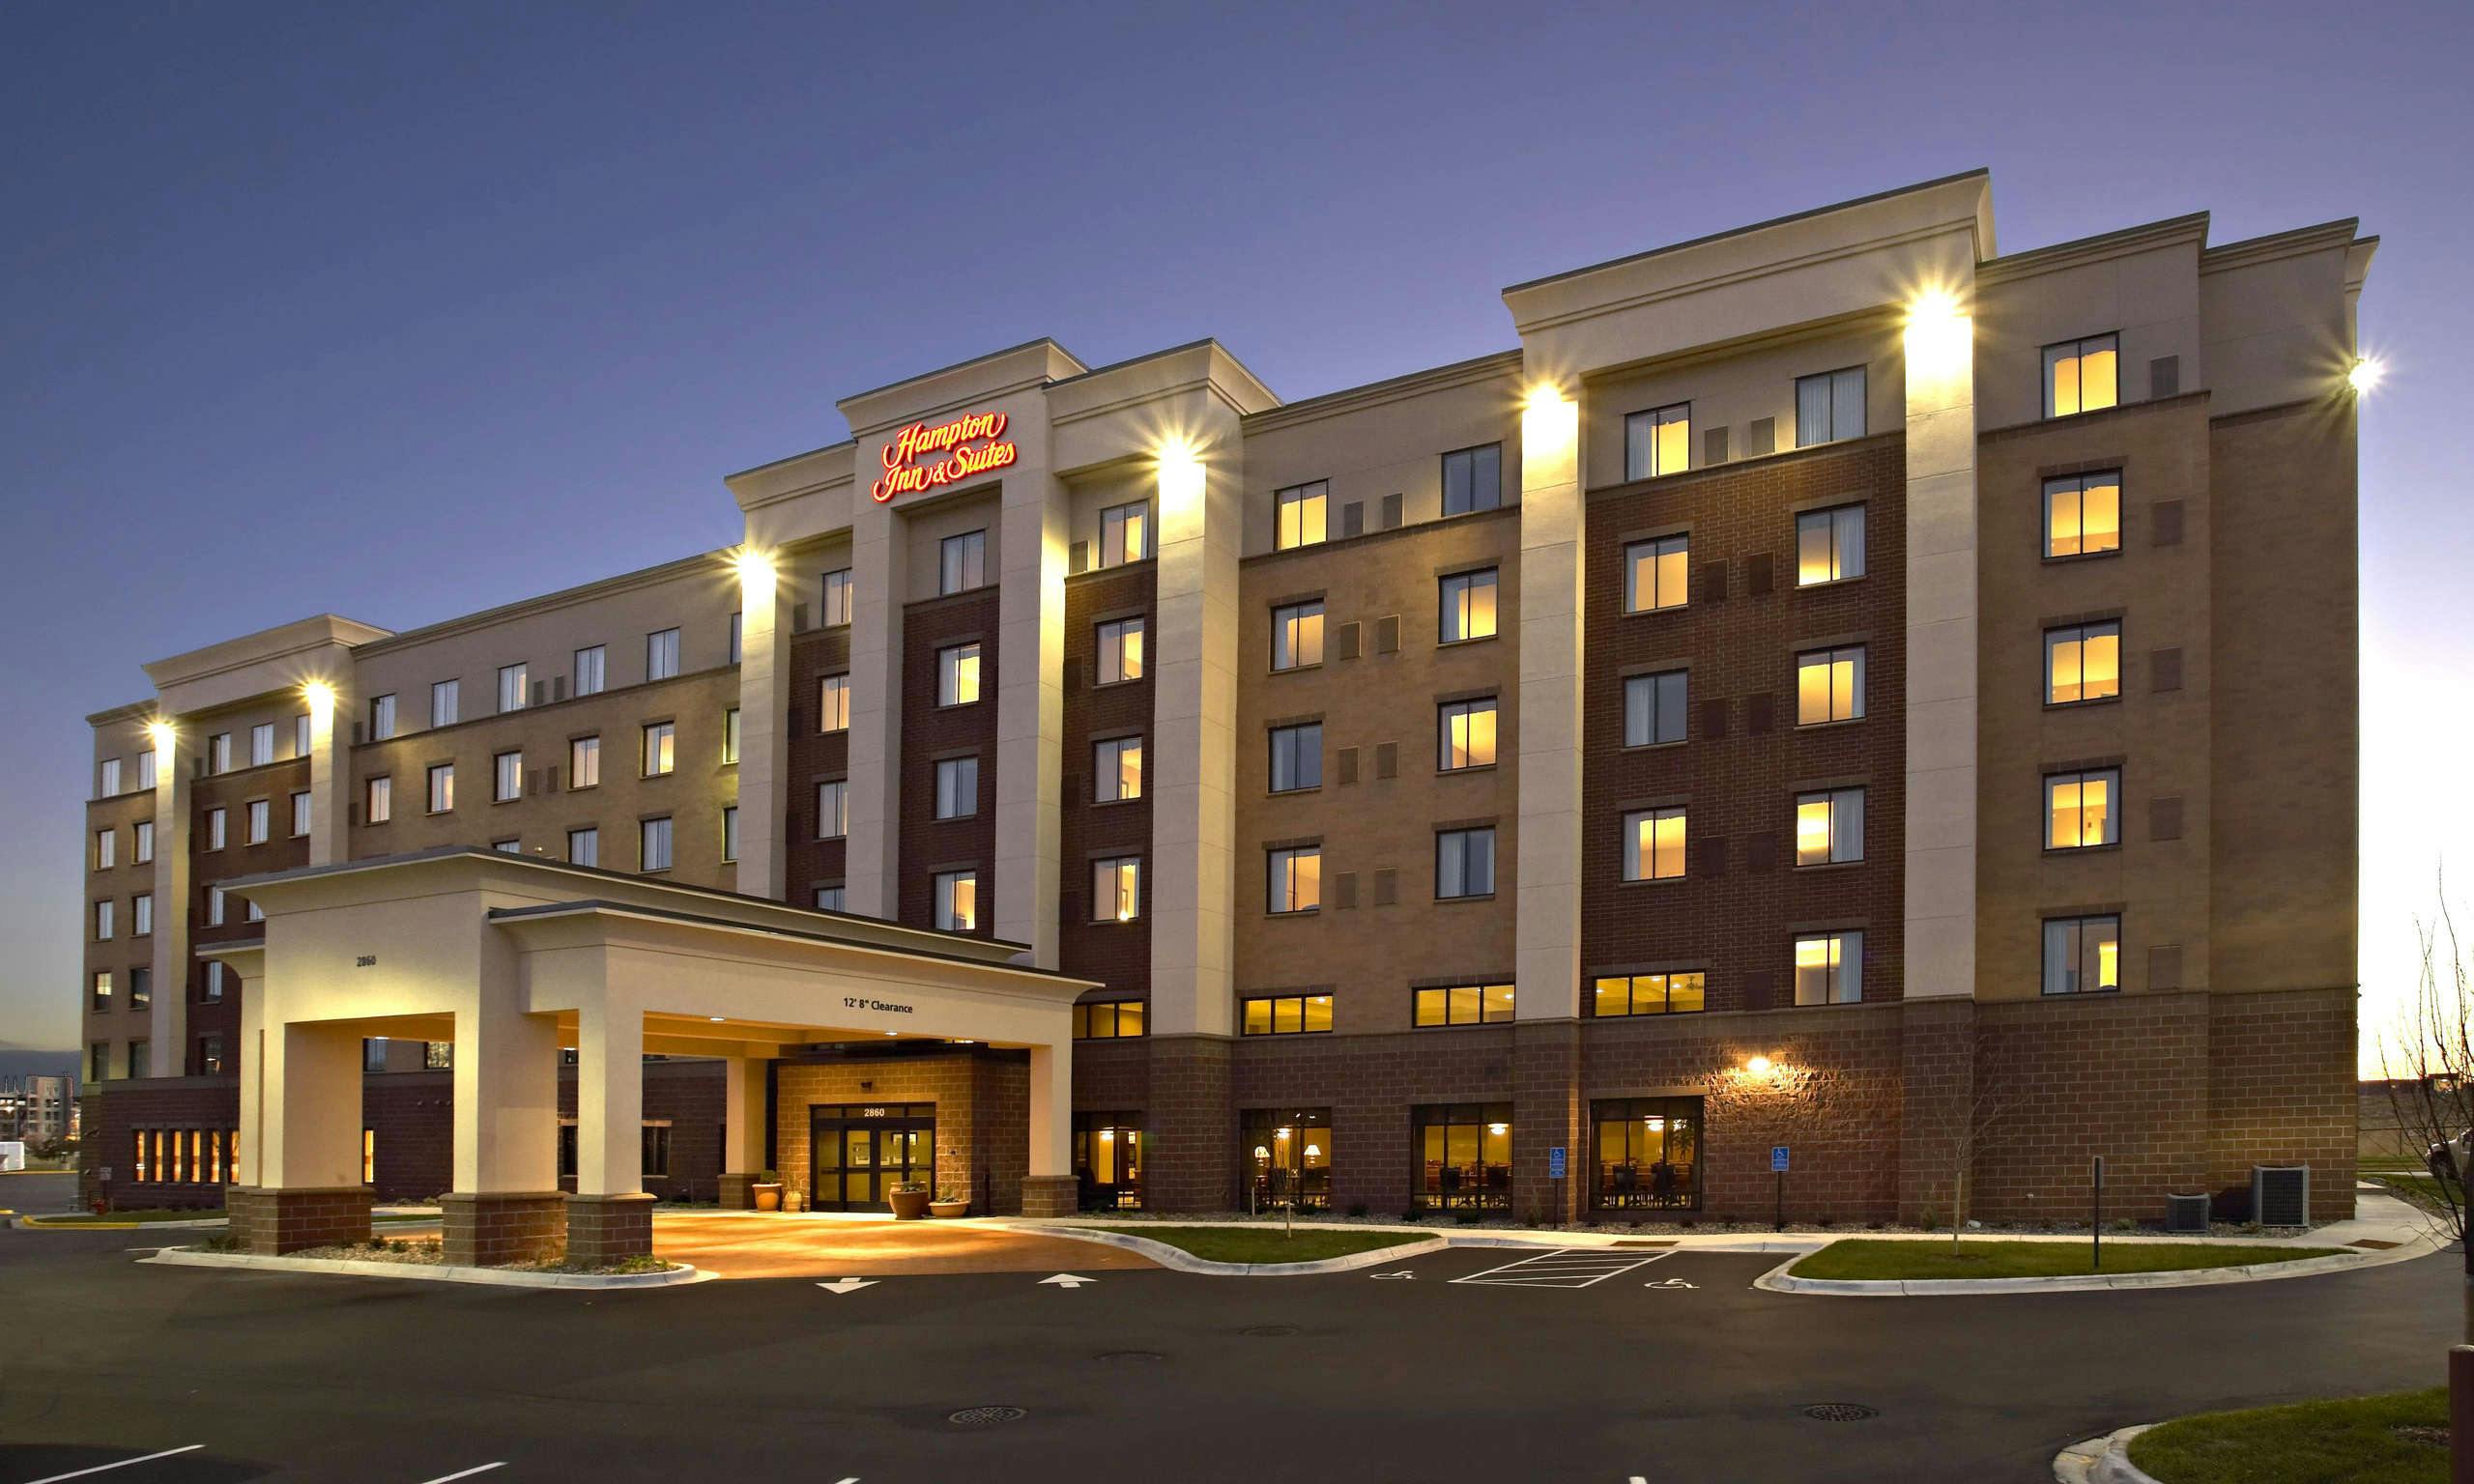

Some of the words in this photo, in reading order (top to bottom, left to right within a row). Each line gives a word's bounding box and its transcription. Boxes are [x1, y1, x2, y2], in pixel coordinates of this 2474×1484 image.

[882, 412, 1008, 469] Hampton
[872, 464, 933, 502] Inn
[933, 461, 948, 483] &
[946, 441, 1018, 479] Suites
[844, 997, 857, 1008] 12'
[871, 1000, 913, 1013] Clearance
[864, 1108, 885, 1117] 2860
